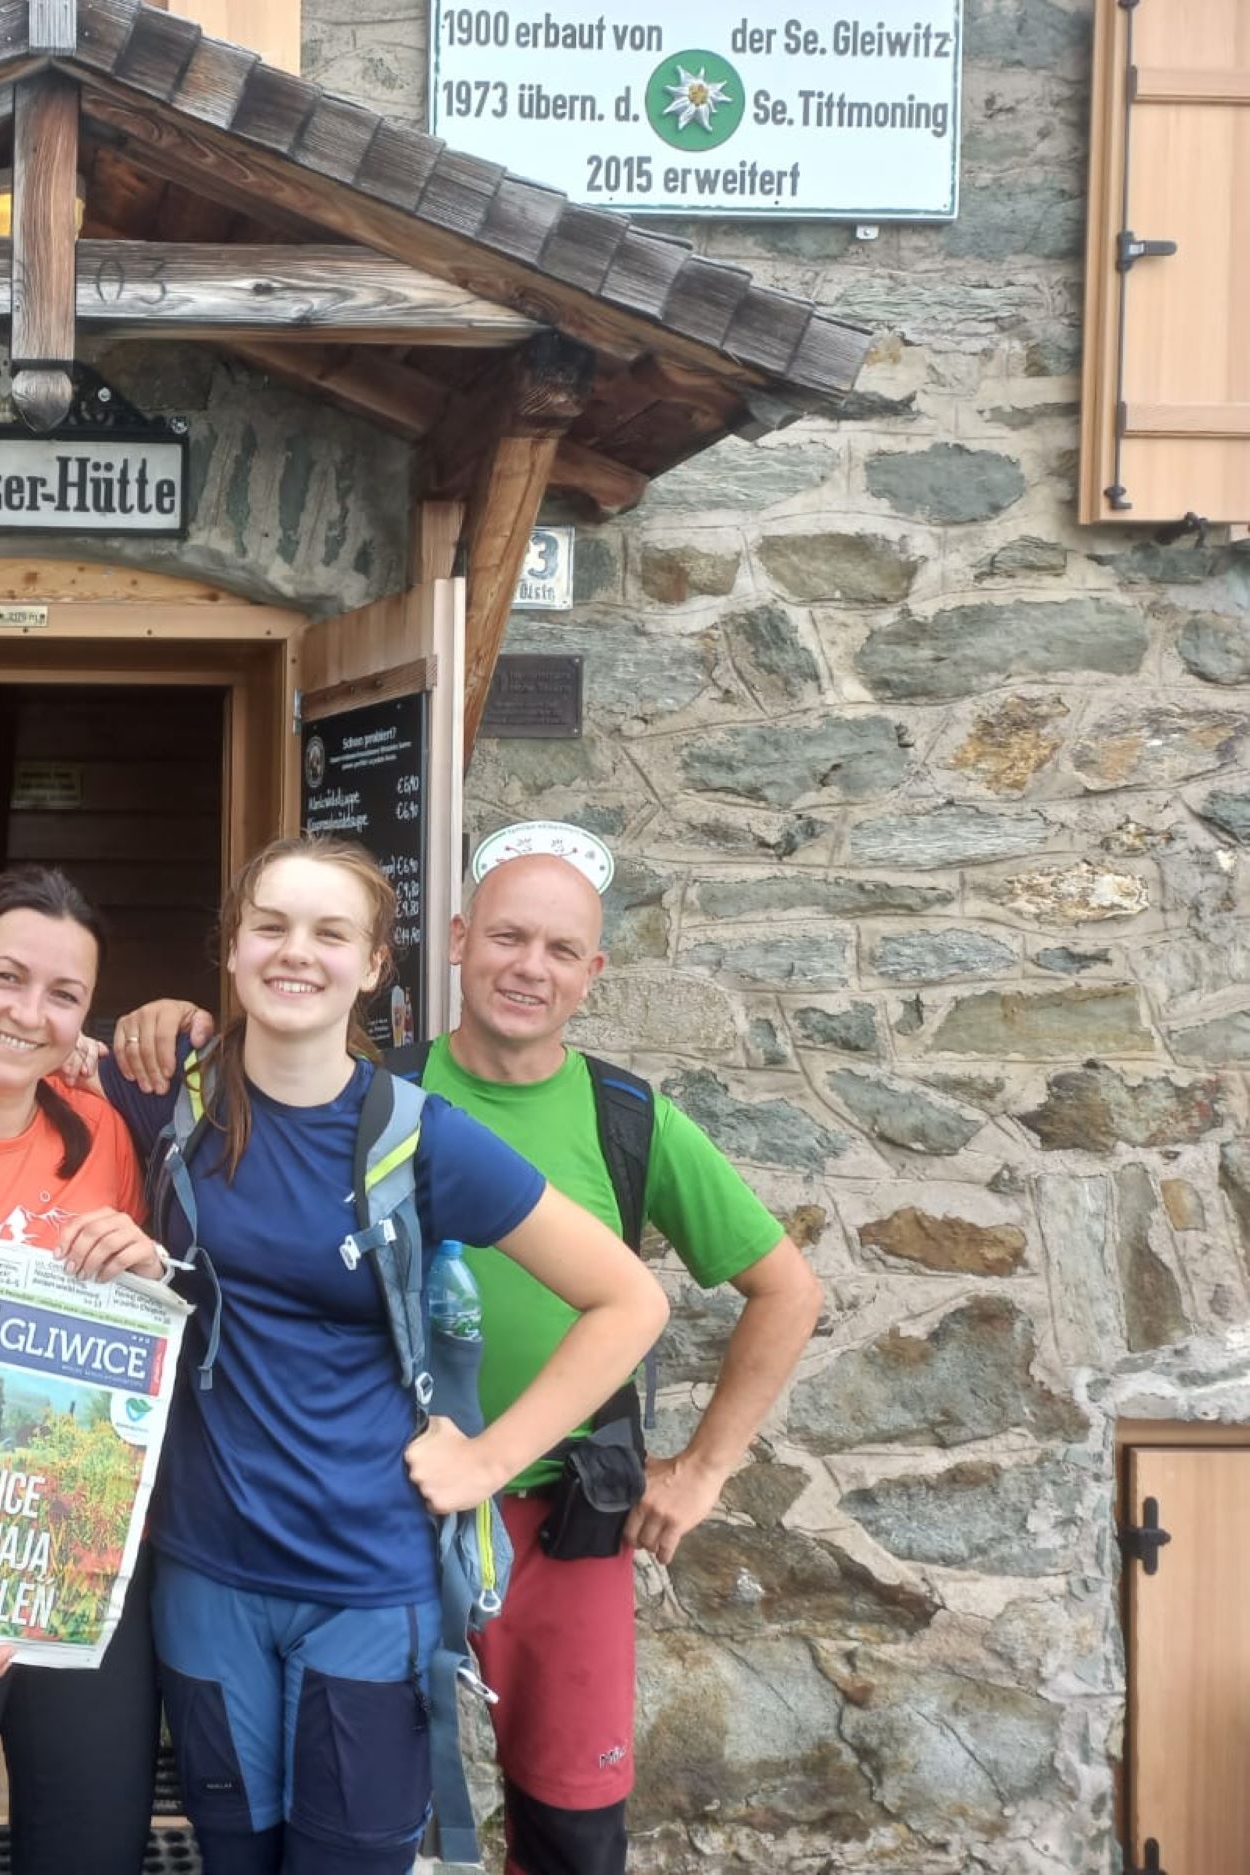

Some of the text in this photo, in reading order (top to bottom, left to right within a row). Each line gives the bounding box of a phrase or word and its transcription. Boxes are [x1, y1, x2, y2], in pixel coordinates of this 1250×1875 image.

[443, 9, 951, 59] 1900 erbaut von der Se. Gleiwitz
[442, 81, 949, 138] 1973 übern. d. Se. Tittmoning
[586, 154, 801, 197] 2015 erweitert
[342, 736, 364, 751] Schon
[0, 1317, 148, 1380] GLIWICE
